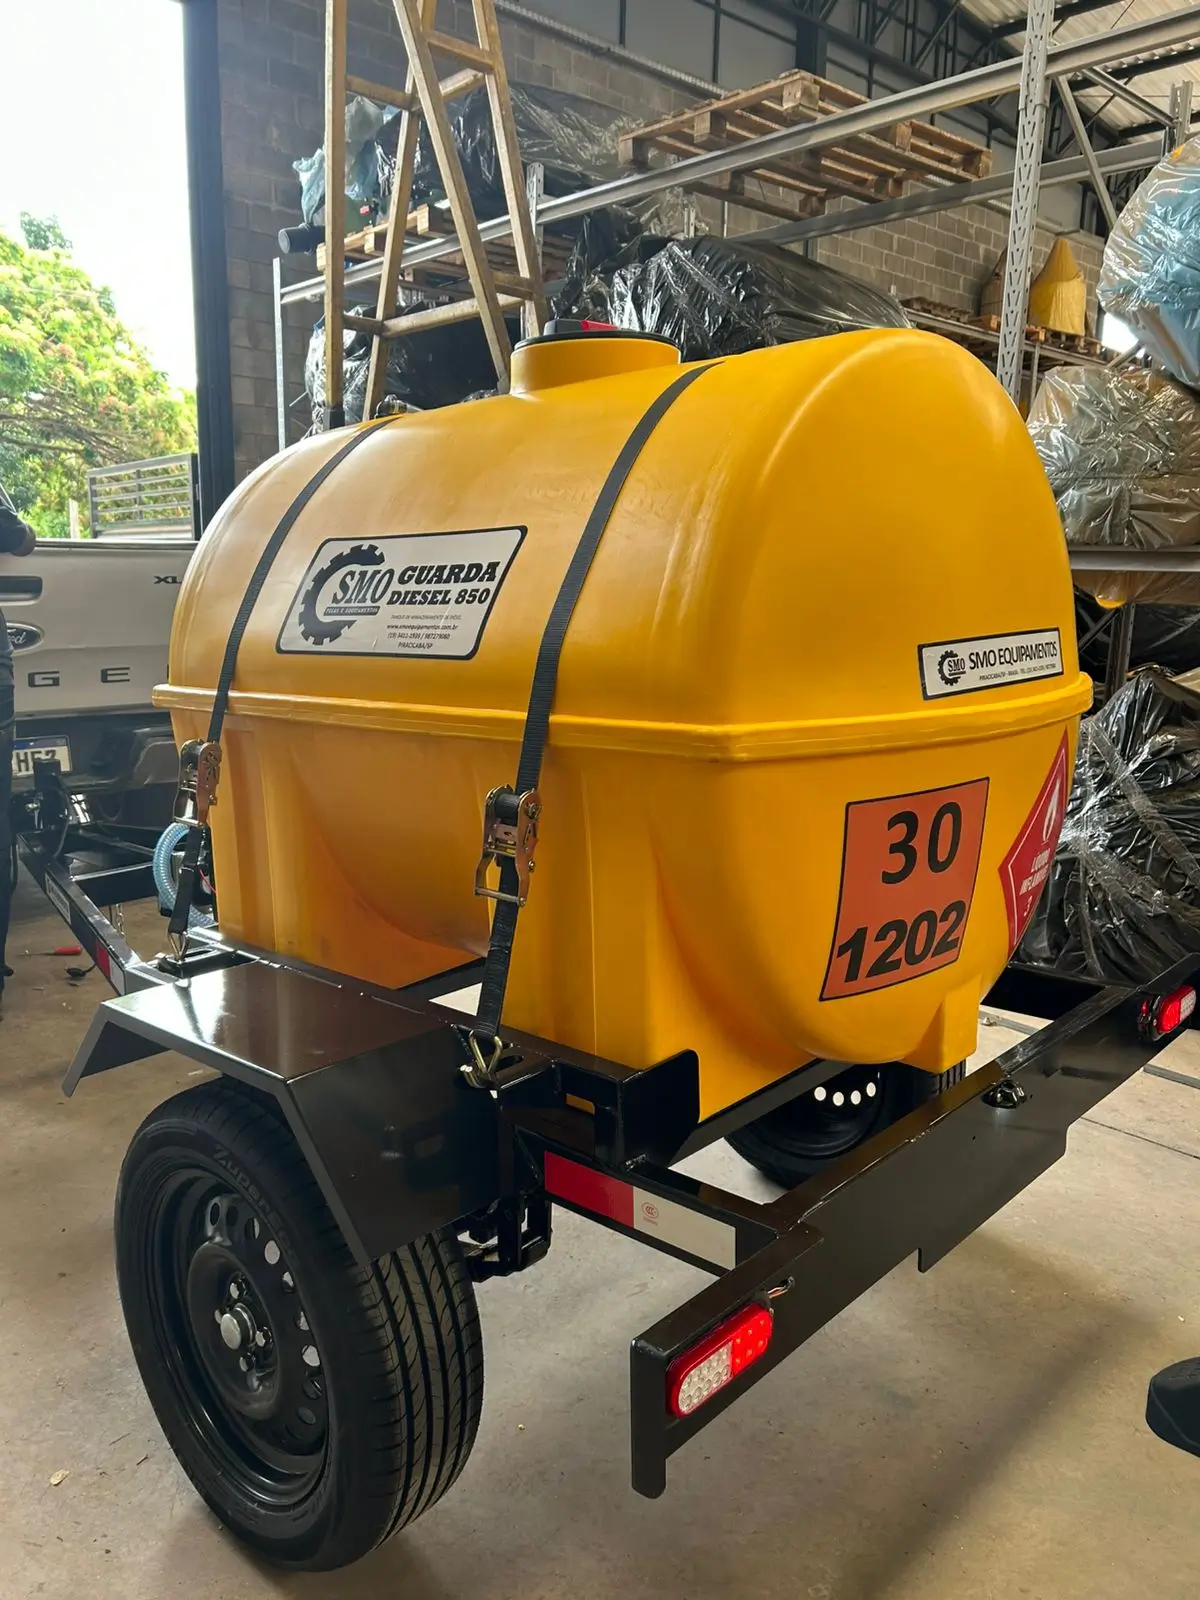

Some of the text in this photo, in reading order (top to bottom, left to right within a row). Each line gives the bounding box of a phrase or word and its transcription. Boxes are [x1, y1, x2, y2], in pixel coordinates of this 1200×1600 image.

[331, 568, 395, 605] SMO
[397, 561, 501, 585] GUARDA
[386, 587, 491, 606] DIESEL 850
[947, 657, 966, 673] SMO
[968, 649, 997, 670] SMO
[999, 641, 1058, 666] EQUIPAMENTOS
[881, 802, 962, 885] 30
[836, 900, 967, 983] 1202
